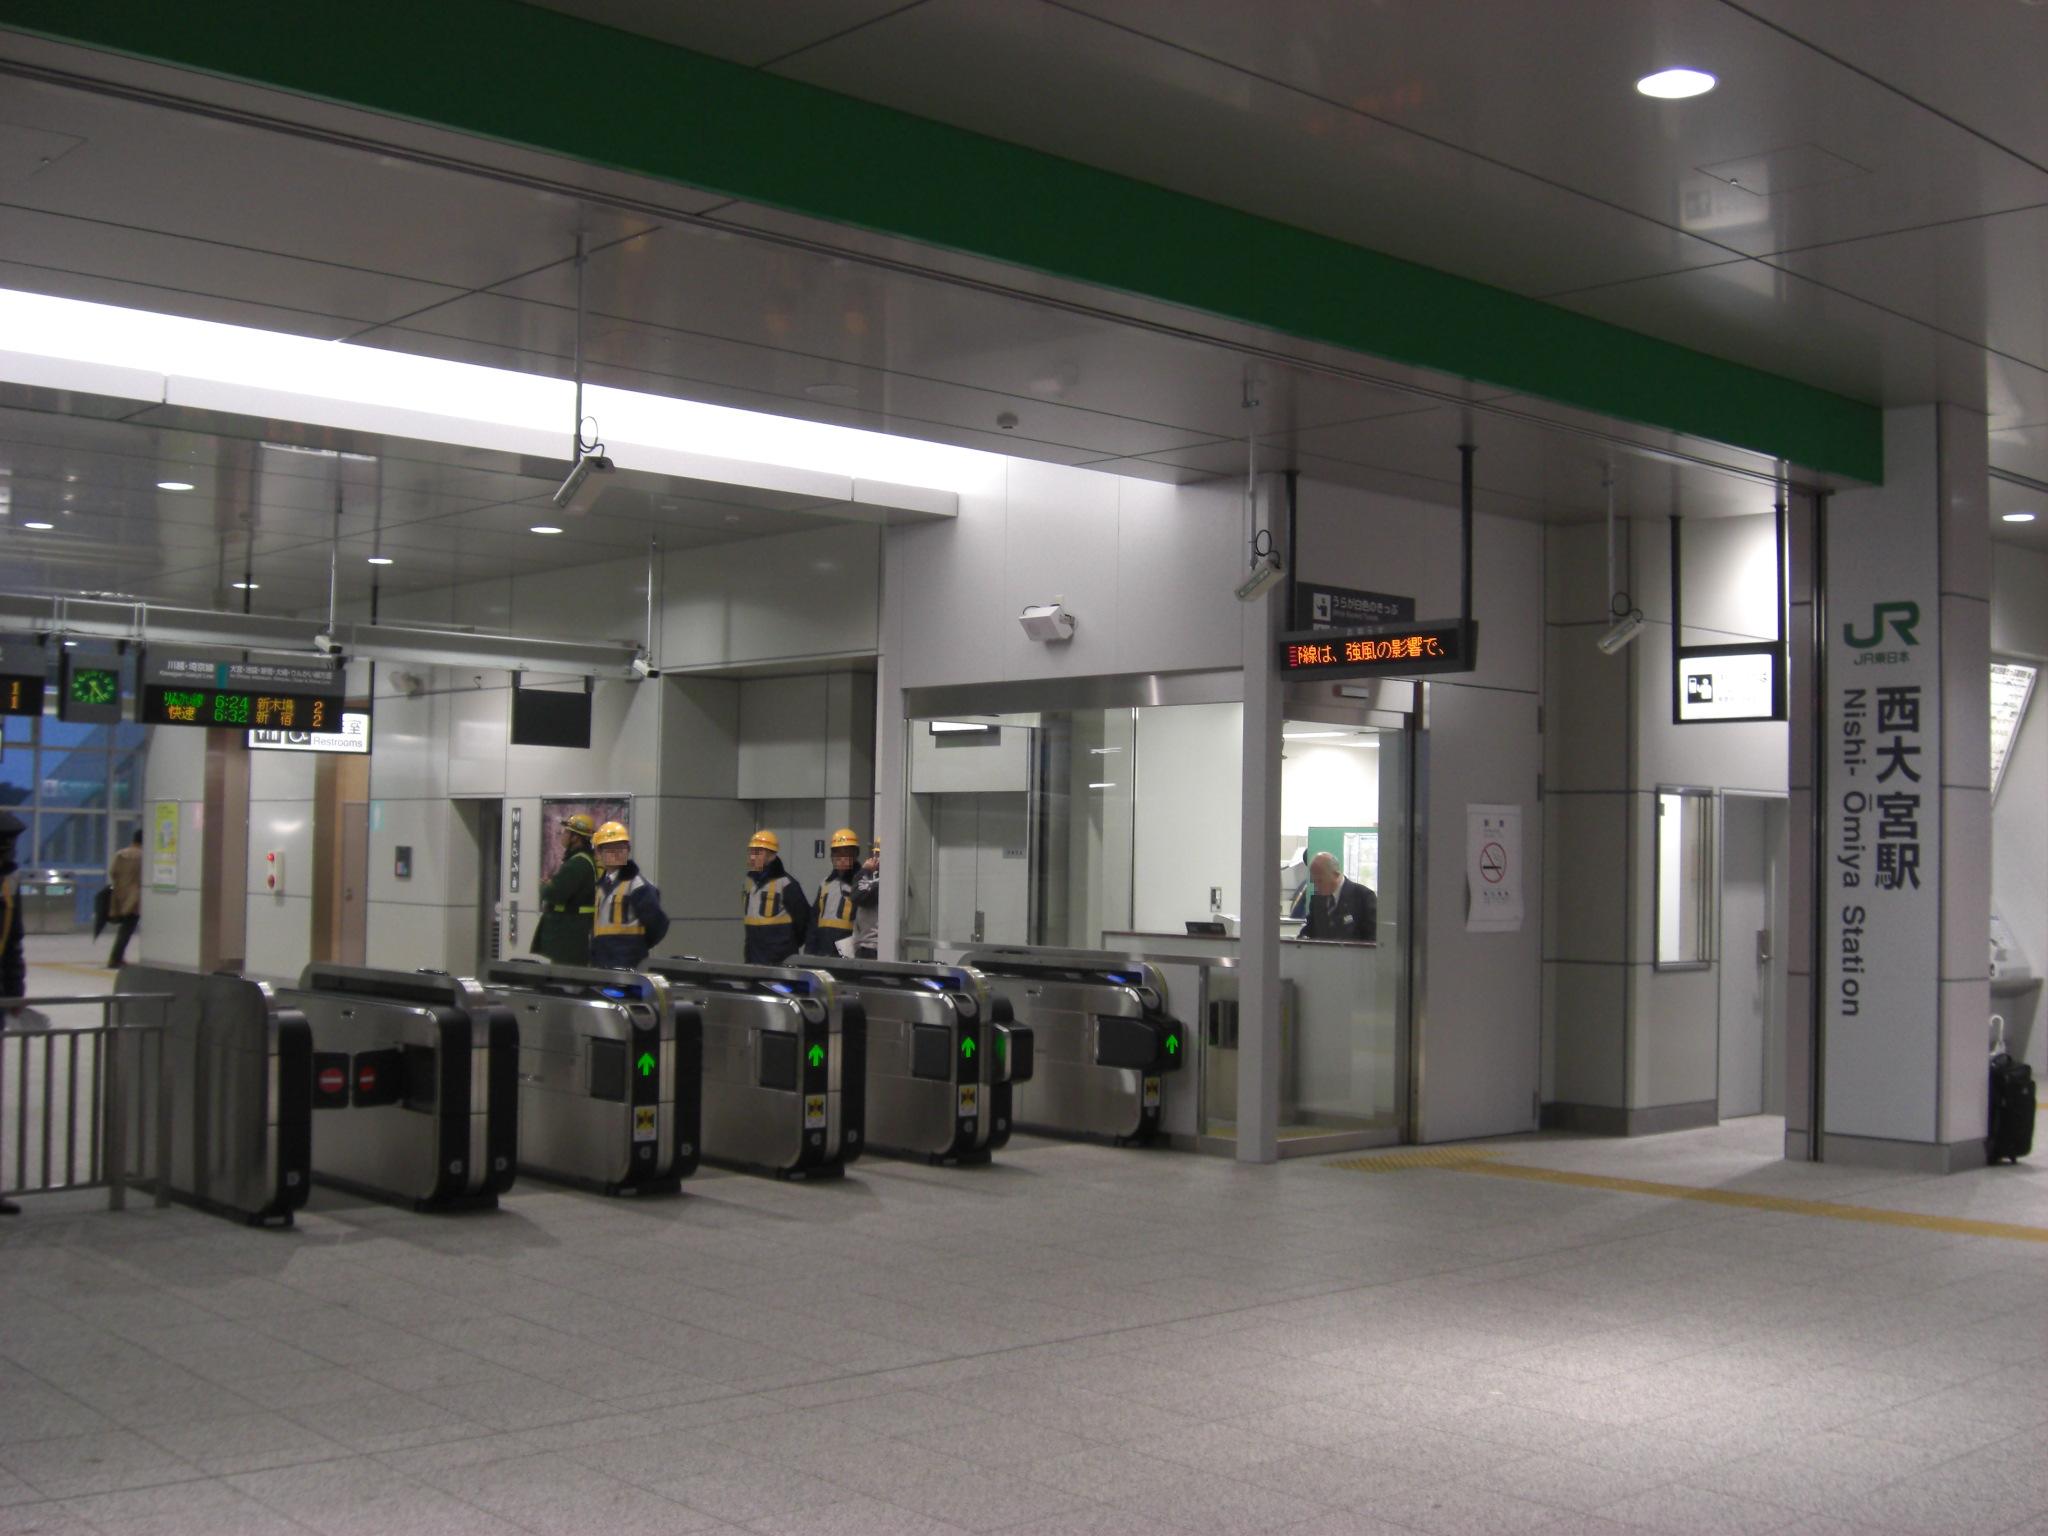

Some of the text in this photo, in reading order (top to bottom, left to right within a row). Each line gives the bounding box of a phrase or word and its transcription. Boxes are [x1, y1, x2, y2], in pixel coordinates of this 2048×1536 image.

[1843, 601, 1920, 649] JR
[1853, 651, 1911, 666] JR東日本
[168, 704, 197, 721] 快速
[213, 709, 249, 723] 6:32
[312, 714, 323, 727] 2
[214, 695, 249, 710] 6:24
[314, 701, 324, 713] 2
[313, 736, 363, 748] Restrooms
[1876, 685, 1921, 891] 西大宮駅
[1842, 905, 1866, 1017] Station
